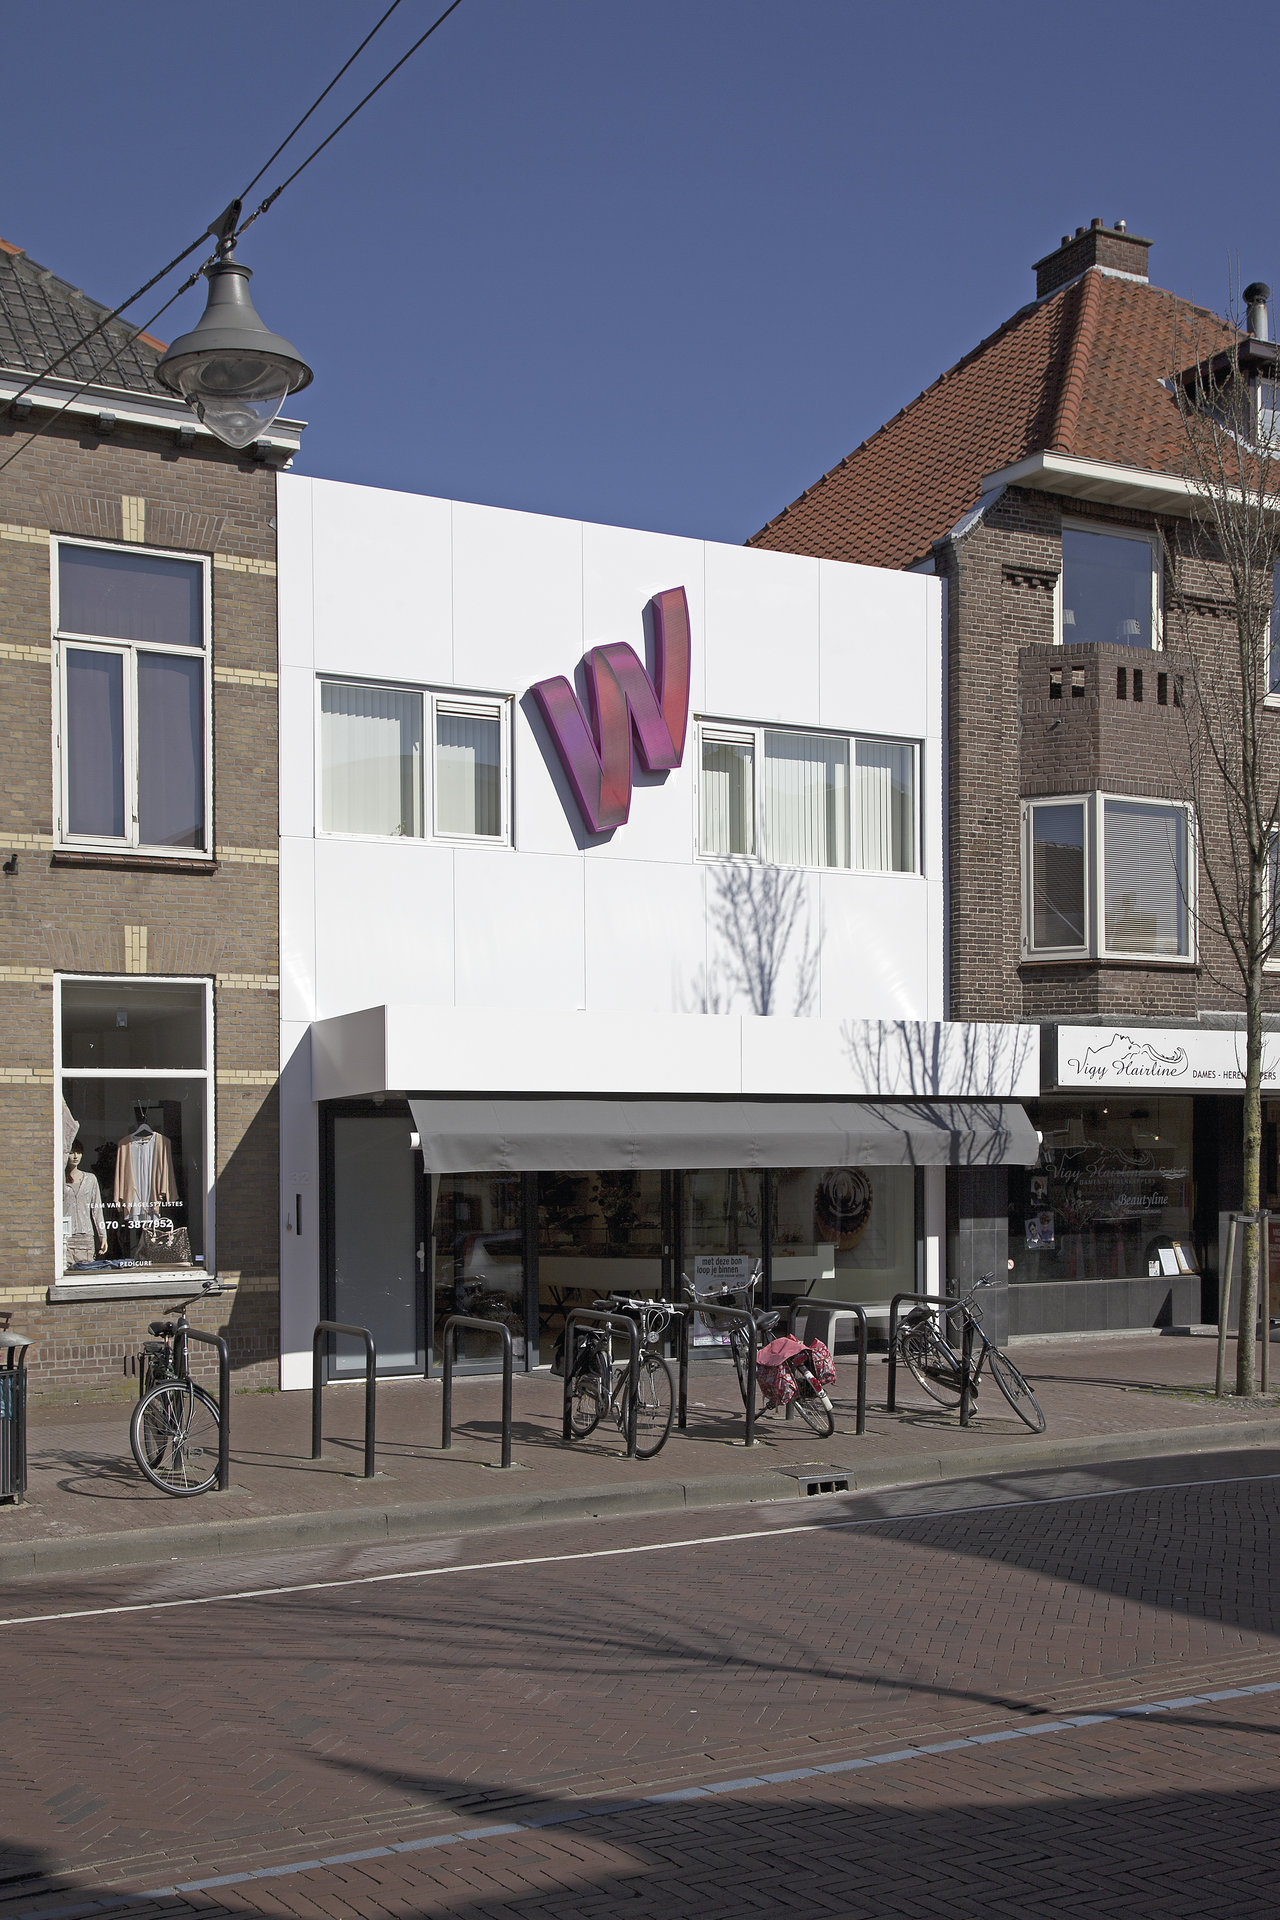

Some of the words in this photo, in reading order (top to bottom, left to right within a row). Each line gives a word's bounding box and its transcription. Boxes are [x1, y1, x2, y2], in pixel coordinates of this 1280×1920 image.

[1067, 1058, 1109, 1080] Vigy
[1112, 1059, 1180, 1078] Hairline
[1192, 1069, 1216, 1079] DAMES
[1223, 1070, 1277, 1081] HERENPERS
[1046, 1164, 1082, 1183] Vigy
[1118, 1191, 1169, 1209] Beautyline
[99, 1220, 119, 1230] 070
[128, 1219, 173, 1229] 3877952
[702, 1257, 715, 1266] met
[715, 1256, 730, 1266] deze
[730, 1256, 743, 1265] bon
[696, 1265, 711, 1275] loop
[711, 1265, 718, 1275] je
[718, 1265, 739, 1274] binnen
